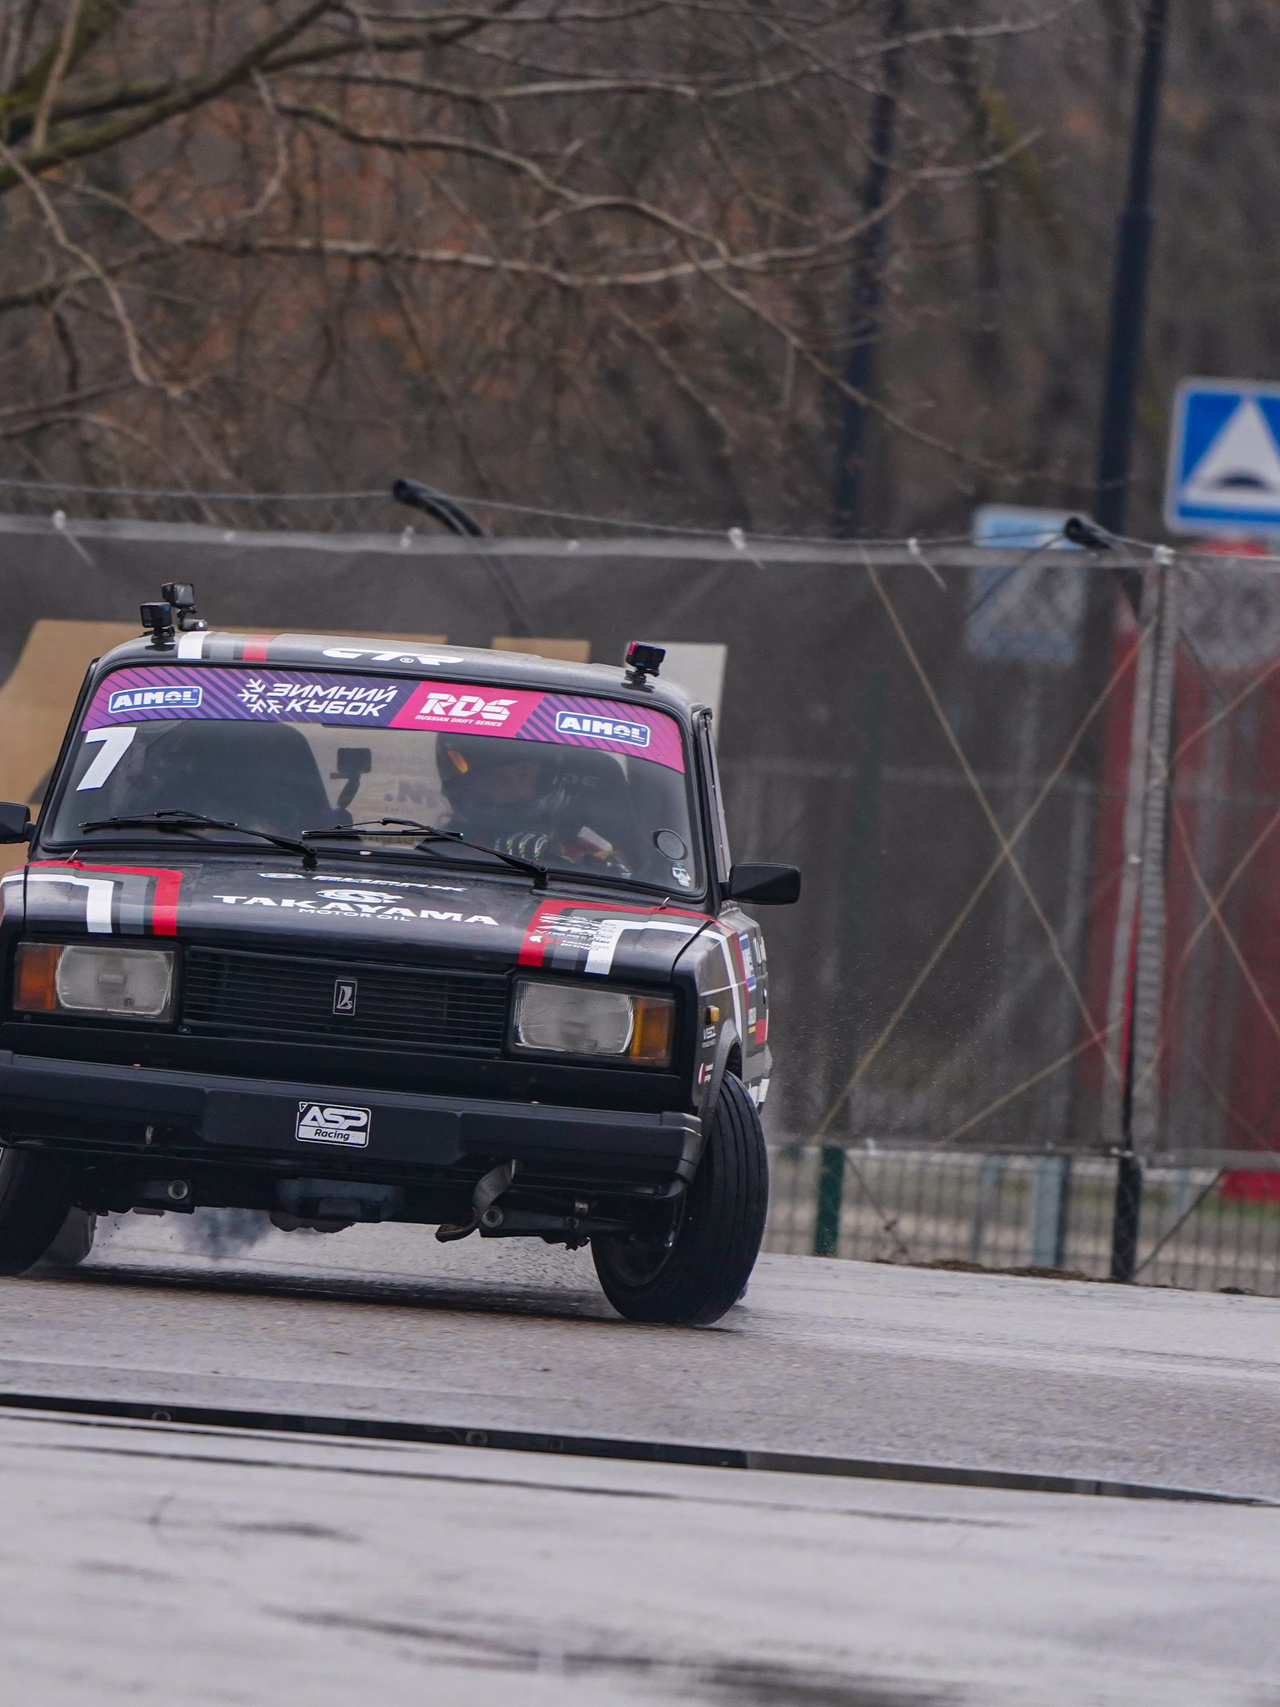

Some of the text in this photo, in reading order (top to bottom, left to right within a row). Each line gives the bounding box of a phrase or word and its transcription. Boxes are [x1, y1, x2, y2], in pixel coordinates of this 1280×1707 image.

[112, 690, 197, 709] AIMOL
[267, 683, 398, 703] ЗИМНИЙ
[285, 699, 387, 717] КУБОК
[419, 692, 519, 721] RDS
[414, 715, 450, 723] RUSSIAN
[560, 716, 645, 742] AIMOL
[76, 726, 138, 791] 7
[212, 895, 500, 926] TAKAYAMA
[298, 908, 411, 922] MOTOR OIL
[299, 1105, 368, 1130] ASP
[313, 1128, 351, 1142] Racing
